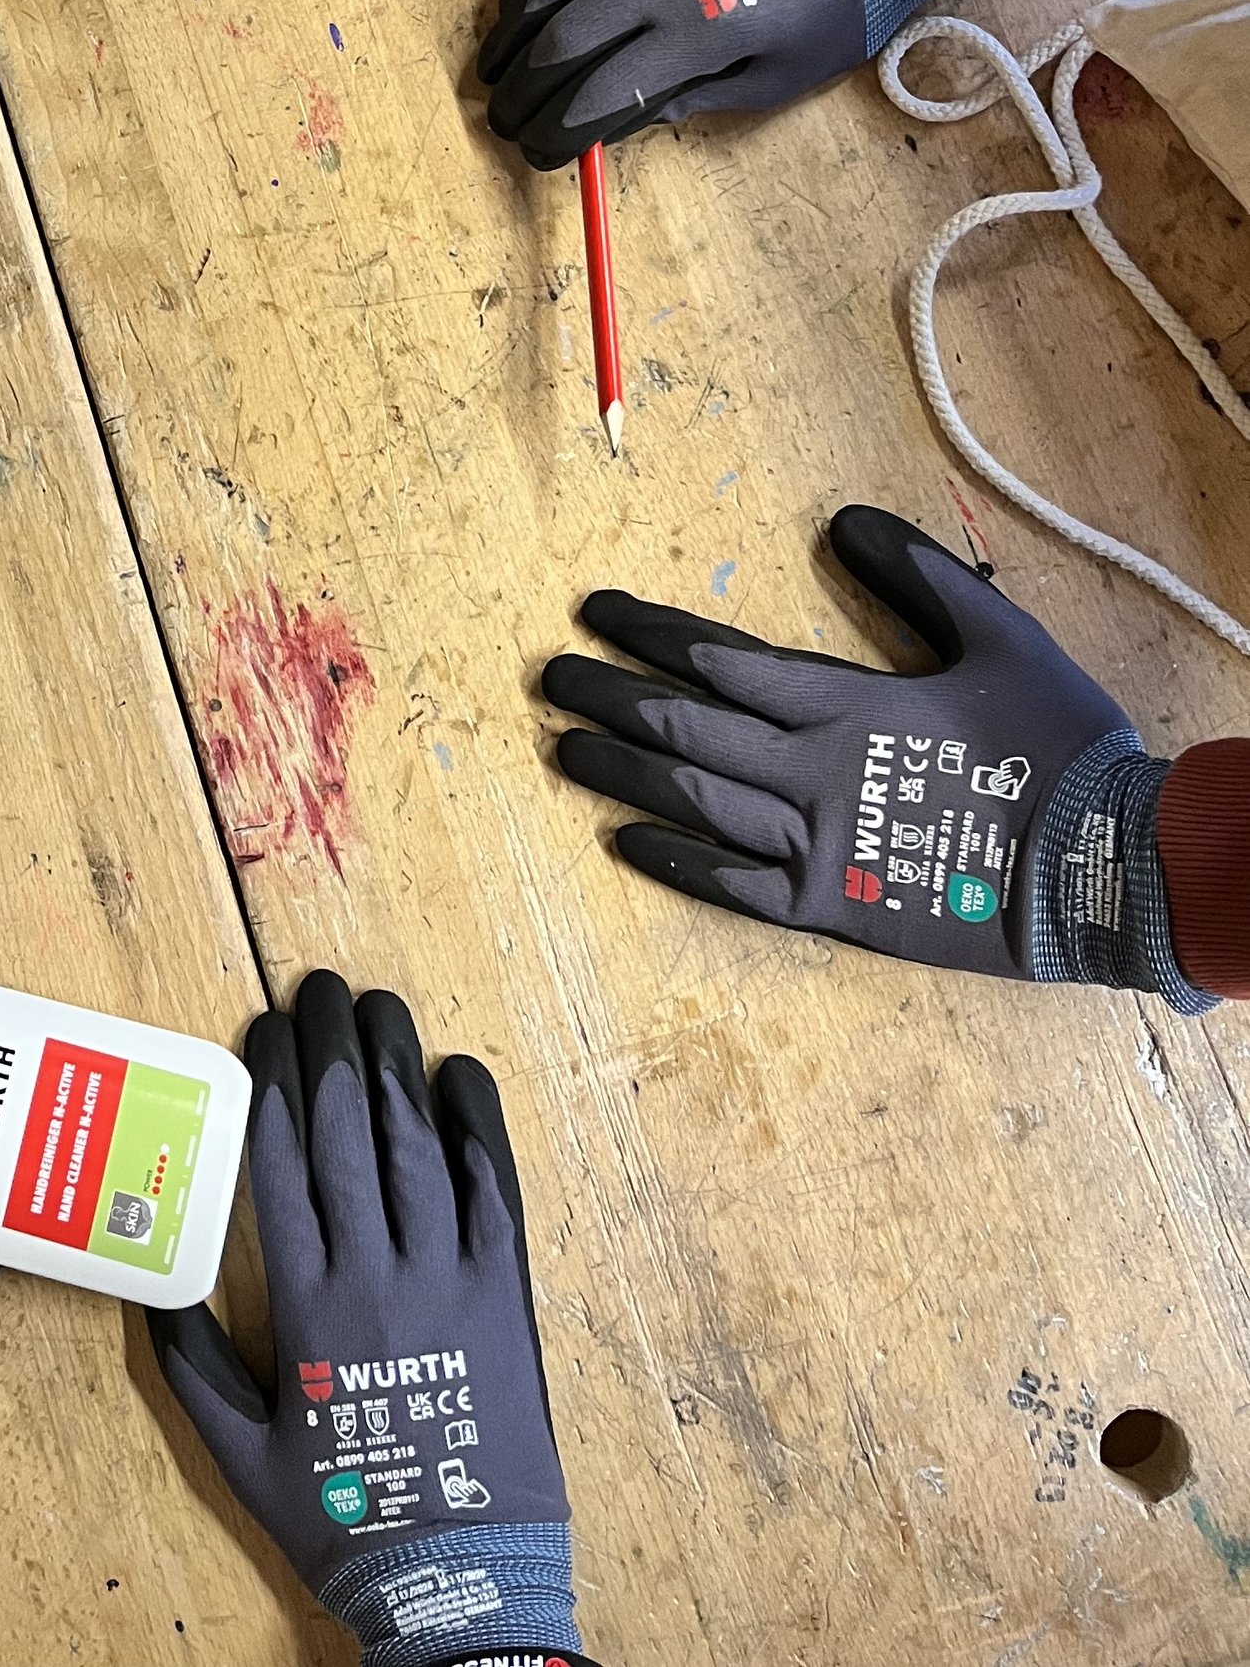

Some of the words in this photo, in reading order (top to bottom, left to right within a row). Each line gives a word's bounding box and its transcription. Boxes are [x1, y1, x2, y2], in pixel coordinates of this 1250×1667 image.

[853, 733, 895, 860] WÜRTH
[939, 809, 955, 835] 218
[936, 836, 950, 860] 405
[955, 810, 975, 872] STANDARD
[932, 861, 946, 892] 0899
[929, 895, 943, 917] Art.
[78, 1071, 102, 1128] N-ACTIVE
[30, 1118, 63, 1214] HANDREINIGER
[52, 1061, 76, 1118] N-ACTIVE
[66, 1128, 89, 1184] CLEANER
[142, 1169, 153, 1193] POWER
[57, 1185, 76, 1222] HAND
[125, 1201, 141, 1233] SKIN
[337, 1349, 467, 1392] WÜRTH
[313, 1459, 335, 1473] Art.
[335, 1452, 365, 1468] 0899
[367, 1448, 390, 1463] 405
[391, 1444, 416, 1460] 218
[363, 1465, 422, 1485] STANDARD
